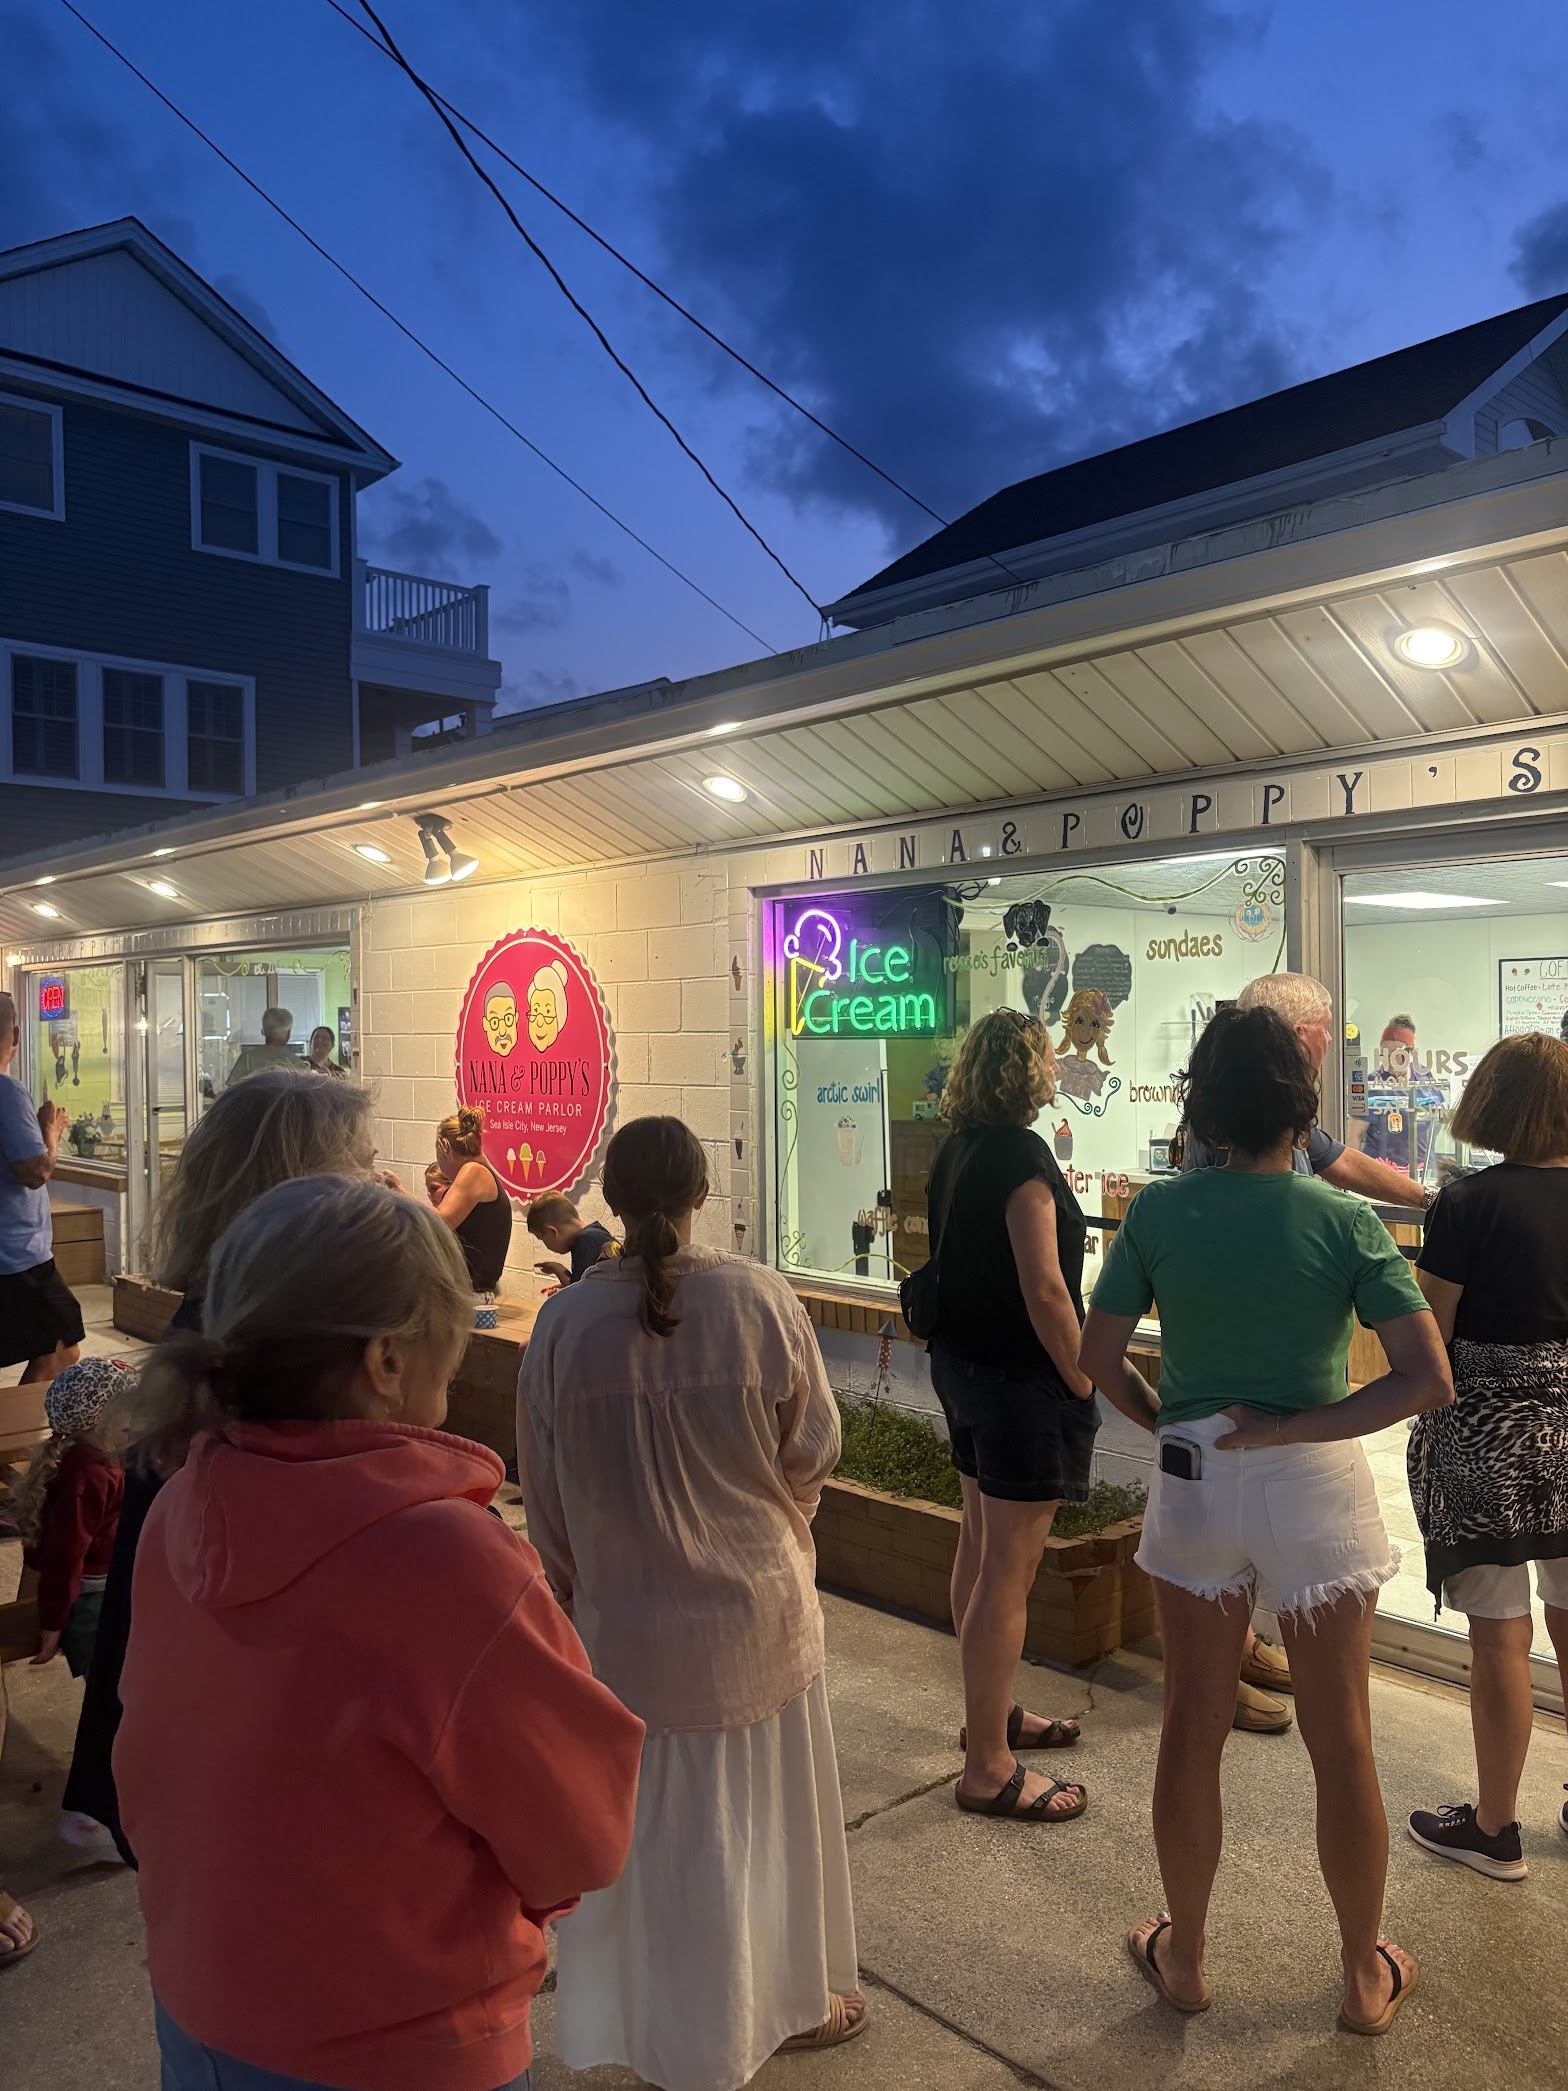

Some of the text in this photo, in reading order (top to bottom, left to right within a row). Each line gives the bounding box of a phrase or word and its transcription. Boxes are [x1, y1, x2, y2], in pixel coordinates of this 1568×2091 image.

[809, 746, 1542, 880] NANA & POPPY'S
[1146, 928, 1223, 962] sundaes
[849, 938, 910, 984] Ice
[989, 944, 1047, 977] favorite
[1540, 960, 1568, 979] COF
[42, 986, 64, 1010] OPEN
[1505, 984, 1516, 992] Hot
[1517, 983, 1538, 992] Coffee
[1542, 982, 1561, 991] Latte
[804, 990, 935, 1034] Cream
[469, 1057, 590, 1097] NANA & POPPY'S
[1373, 1047, 1469, 1077] HOURS
[817, 1077, 880, 1104] arctic swirl
[496, 1100, 533, 1115] CREAM
[538, 1101, 582, 1117] PARLOR
[489, 1118, 567, 1136] Sea Isle City, New Jersey
[1101, 1168, 1130, 1198] ice
[857, 1205, 899, 1237] waffle
